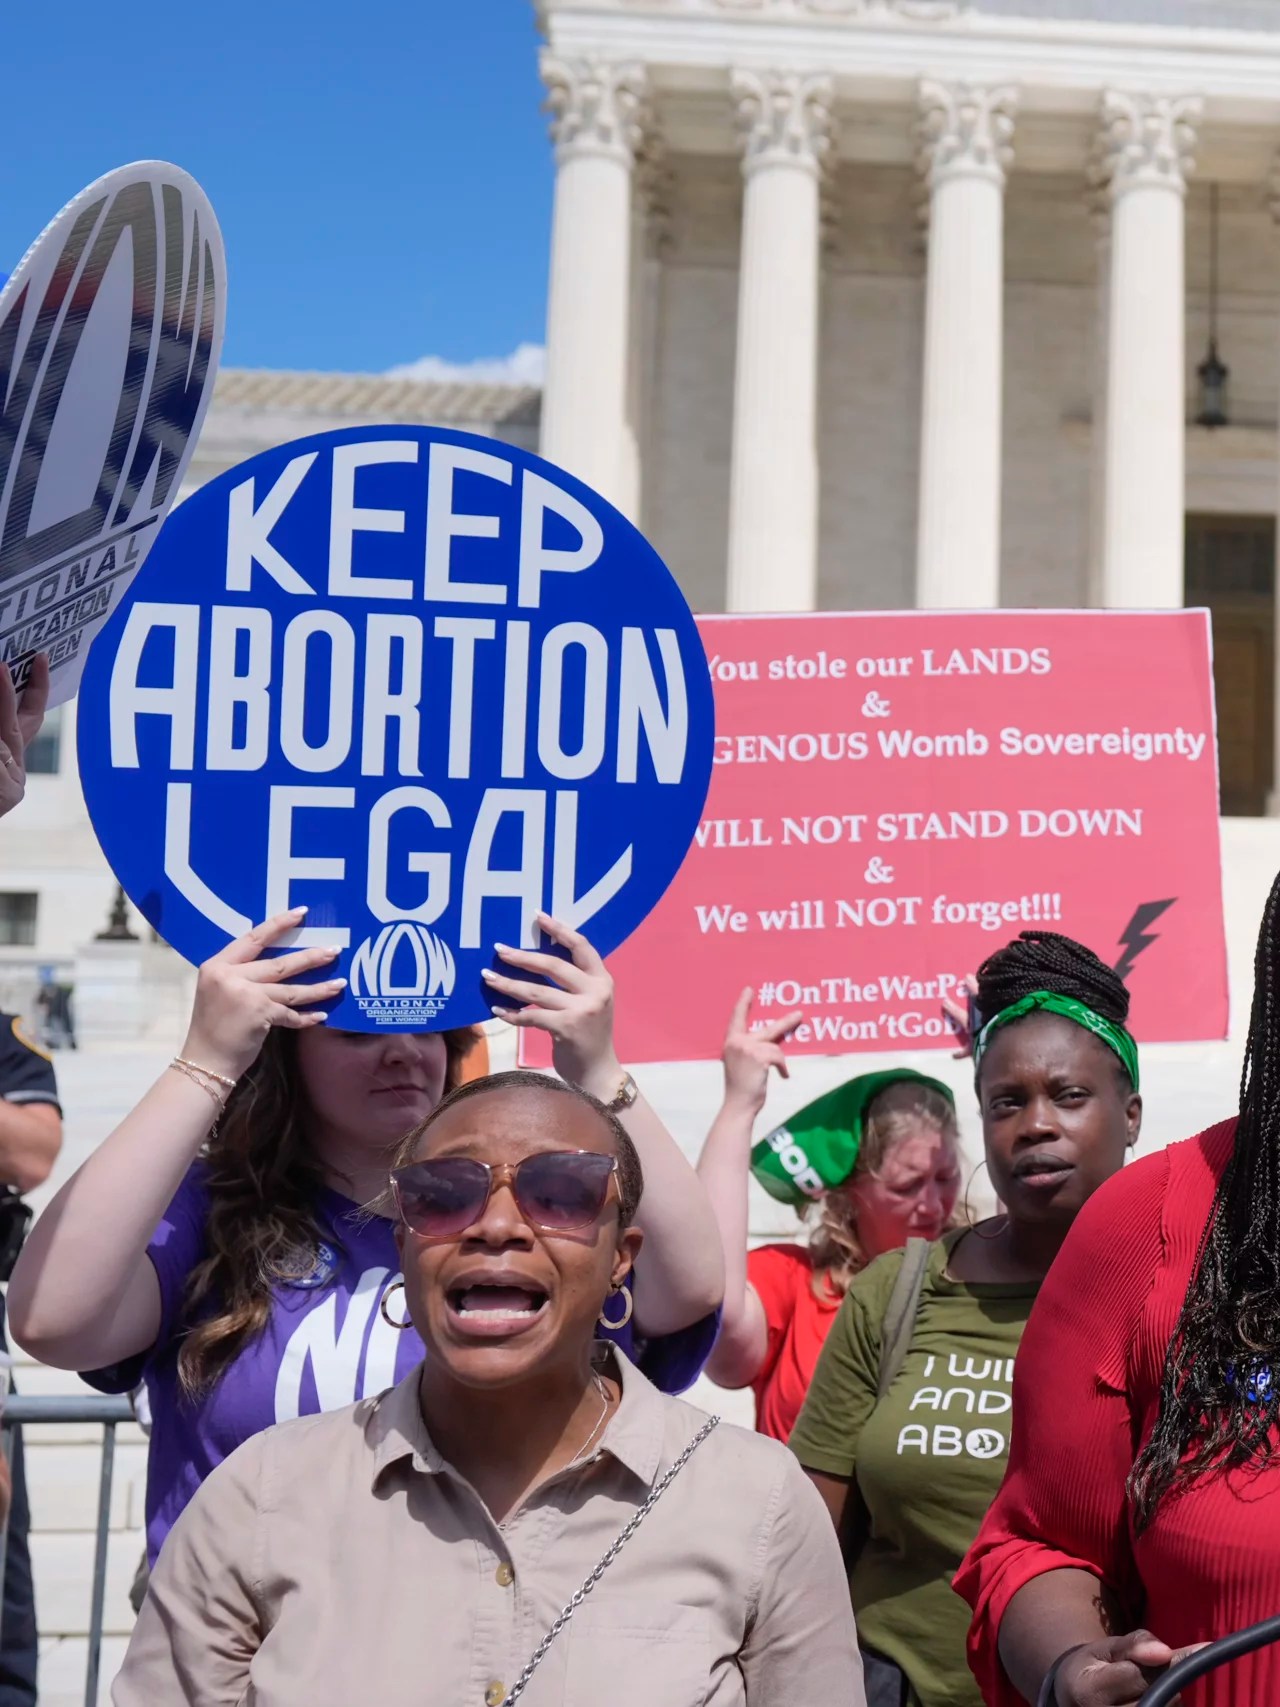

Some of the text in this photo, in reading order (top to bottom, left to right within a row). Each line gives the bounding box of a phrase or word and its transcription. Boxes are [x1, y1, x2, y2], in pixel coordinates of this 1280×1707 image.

[226, 440, 604, 608] KEEP
[768, 651, 847, 680] stole
[856, 656, 913, 678] our
[921, 648, 1052, 676] LANDS
[109, 602, 689, 784] ABORTION
[861, 691, 891, 718] &
[877, 728, 989, 759] Womb
[999, 727, 1206, 761] Sovereignty
[781, 815, 867, 844] NOT
[876, 810, 1008, 842] STAND
[1018, 808, 1143, 839] DOWN
[164, 782, 634, 949] LEGAL
[864, 856, 895, 884] &
[694, 893, 1062, 934] We will NOT forget!!!
[349, 923, 456, 997] NOW
[358, 1000, 445, 1008] NATIONAL
[924, 1355, 936, 1377] I
[909, 1386, 1012, 1414] AND
